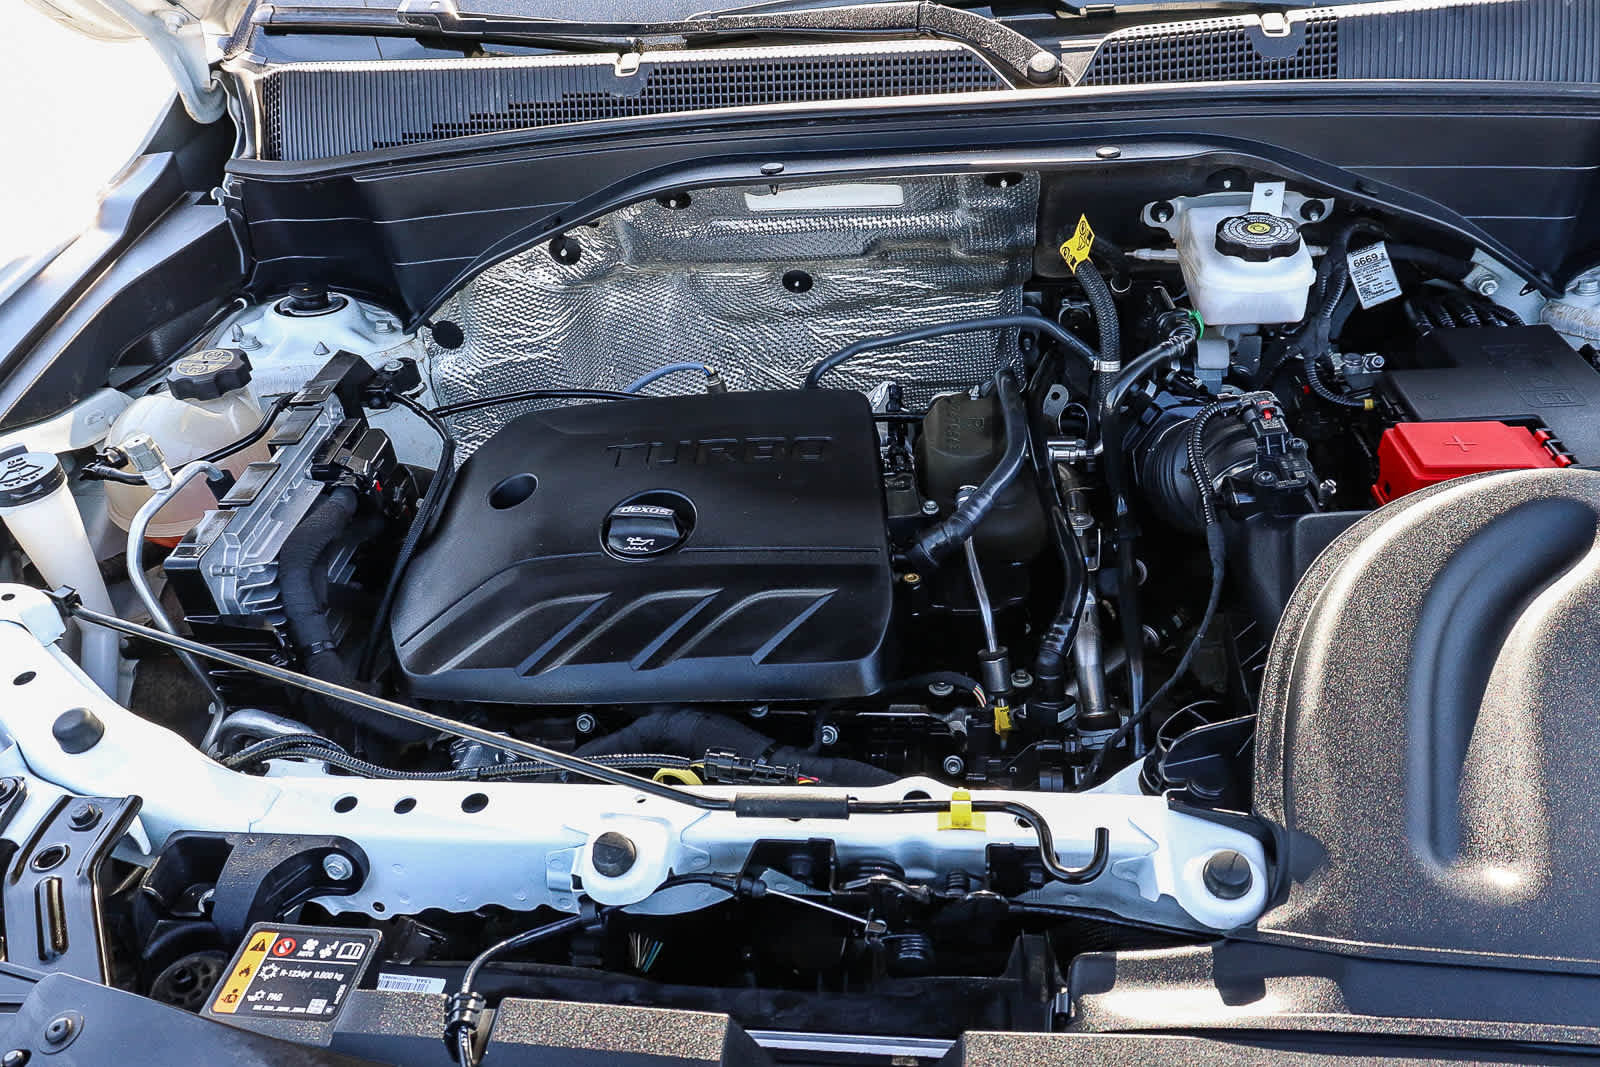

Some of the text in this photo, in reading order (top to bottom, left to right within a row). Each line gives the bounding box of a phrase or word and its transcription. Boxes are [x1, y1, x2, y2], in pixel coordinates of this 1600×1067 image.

[1353, 253, 1378, 267] 6669
[605, 435, 834, 468] TURBO
[267, 993, 283, 1001] PAG
